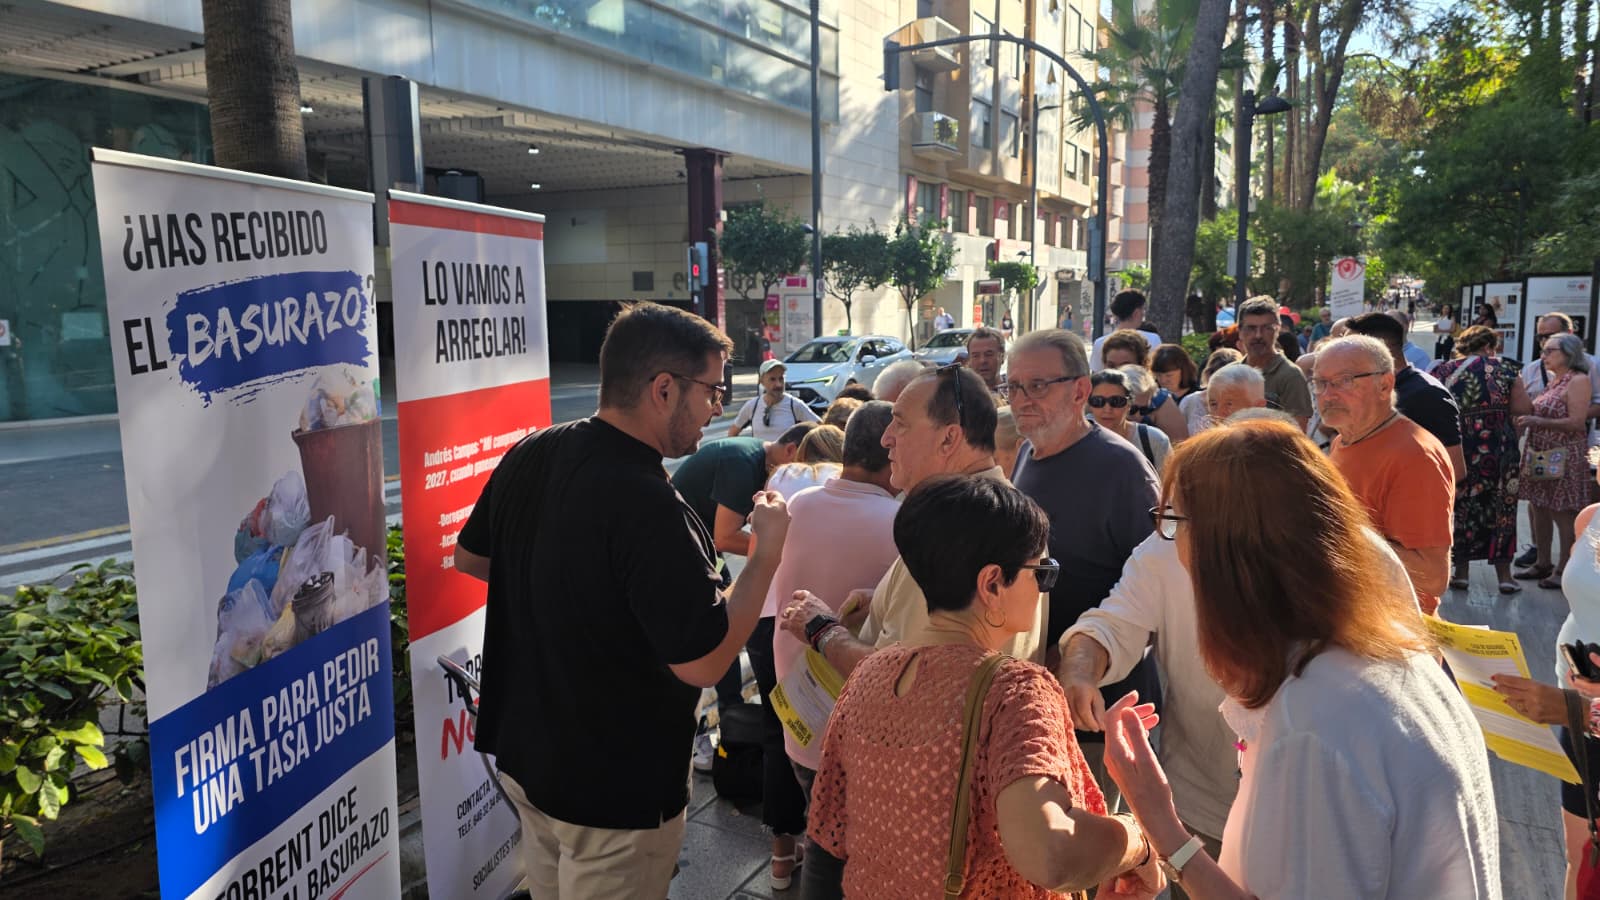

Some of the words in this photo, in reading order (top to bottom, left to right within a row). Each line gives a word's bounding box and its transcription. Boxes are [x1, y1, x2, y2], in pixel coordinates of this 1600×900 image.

[123, 213, 206, 271] ¿HAS
[211, 210, 328, 263] RECIBIDO
[422, 260, 448, 306] LO
[452, 262, 511, 306] VAMOS
[515, 265, 526, 304] A
[123, 317, 168, 376] EL
[436, 316, 527, 364] ARREGLAR!
[174, 707, 256, 798] FIRMA
[262, 671, 320, 741] PARA
[323, 638, 379, 701] PEDIR
[192, 762, 245, 834] UNA
[249, 720, 311, 792] TASA
[315, 681, 372, 752] JUSTA
[320, 786, 358, 850] DICE
[457, 778, 491, 820] CONTACTA
[308, 807, 389, 900] BASURAZO
[473, 838, 511, 891] SOCIALISTES
